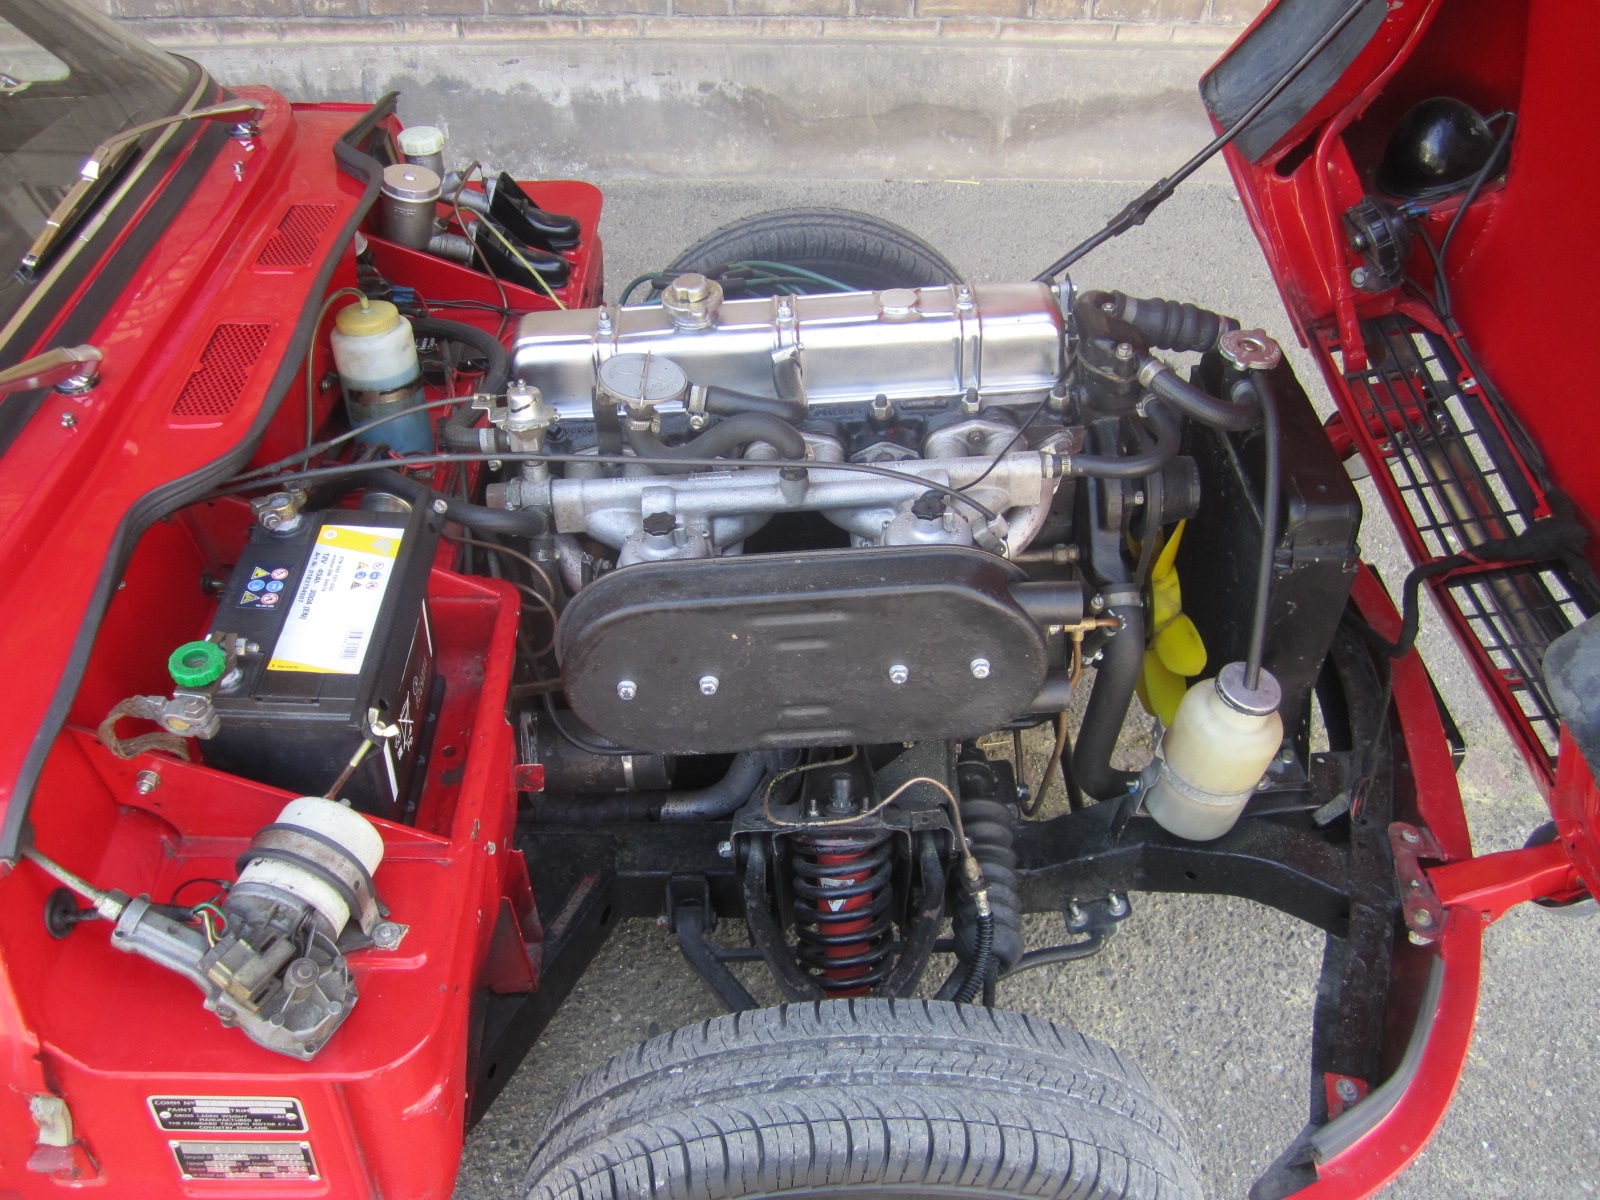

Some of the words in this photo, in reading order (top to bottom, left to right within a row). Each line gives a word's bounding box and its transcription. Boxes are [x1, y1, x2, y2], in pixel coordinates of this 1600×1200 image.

[320, 552, 330, 564] 12V
[313, 568, 324, 584] 45Ah
[305, 588, 317, 604] 300A
[299, 606, 310, 620] (EN)
